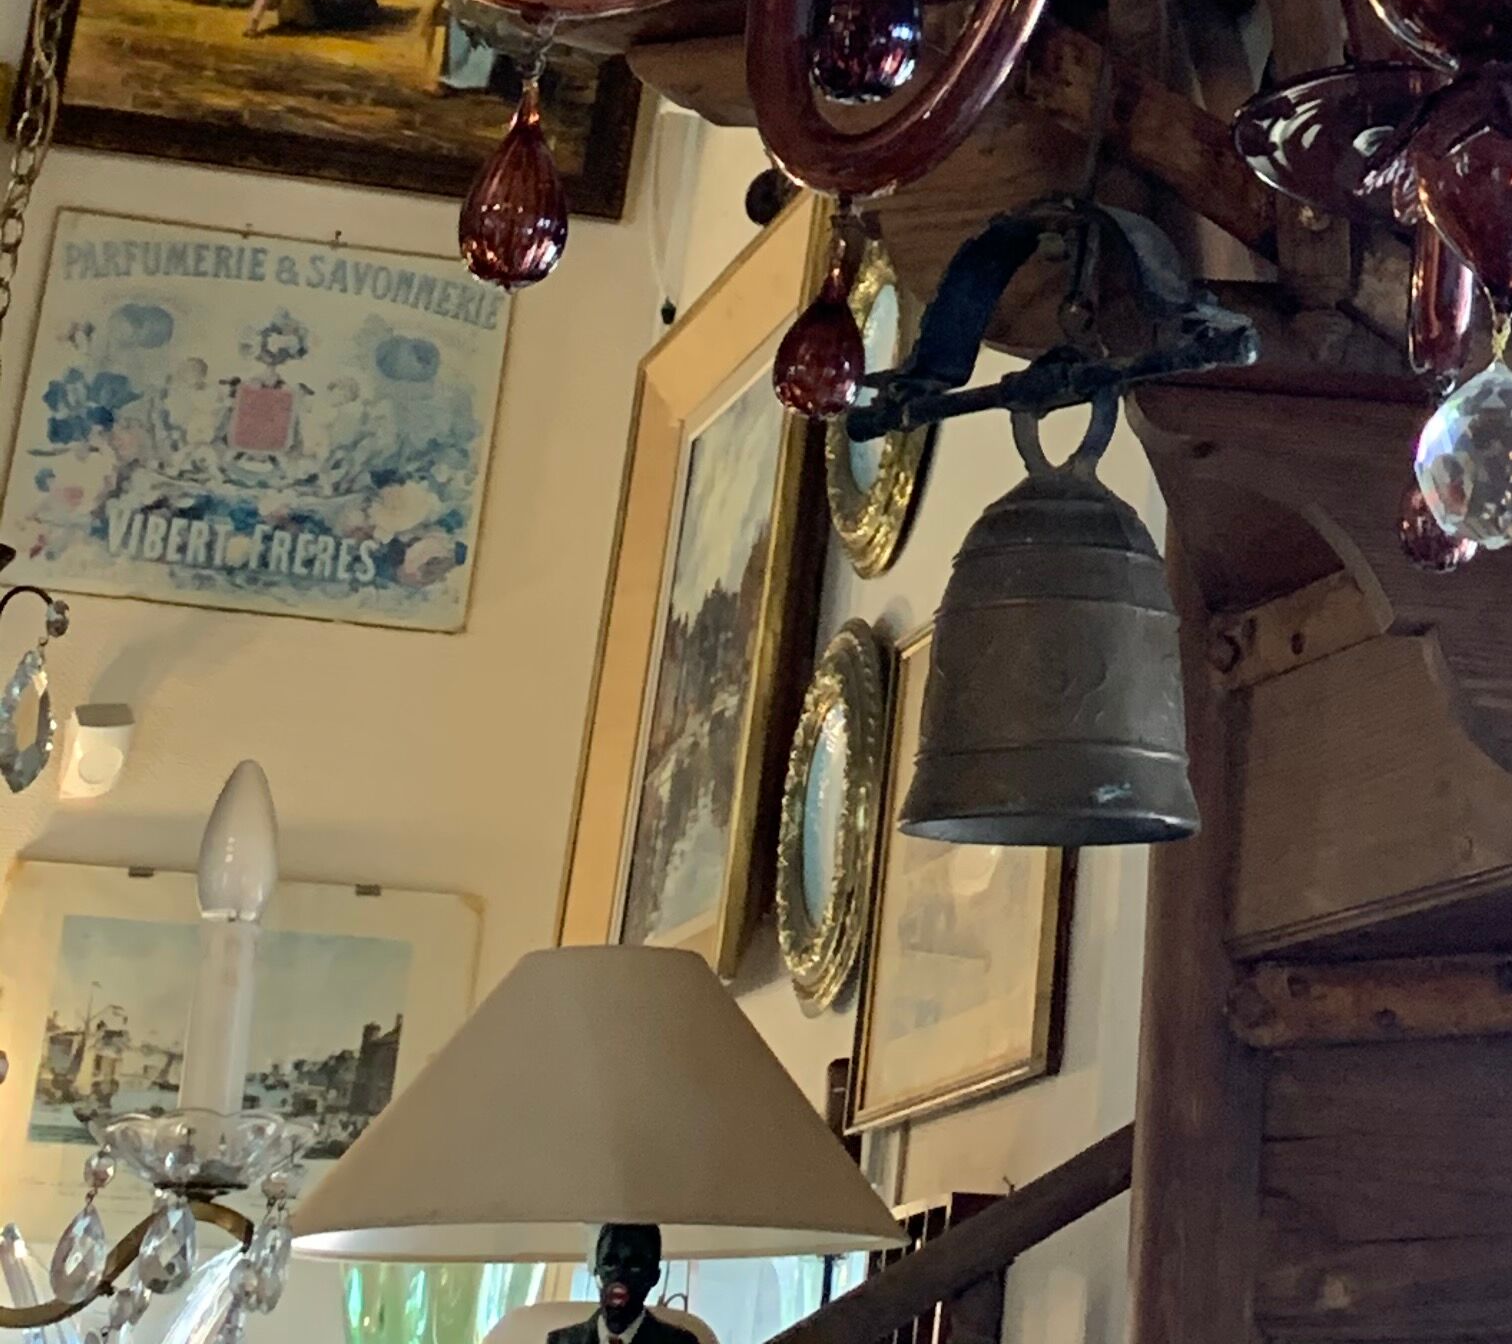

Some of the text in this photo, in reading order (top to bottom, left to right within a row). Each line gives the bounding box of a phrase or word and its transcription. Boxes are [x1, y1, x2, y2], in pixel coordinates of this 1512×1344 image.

[64, 240, 503, 330] PARFUMERIE & SAVONNERIE
[106, 499, 234, 567] VIBERT
